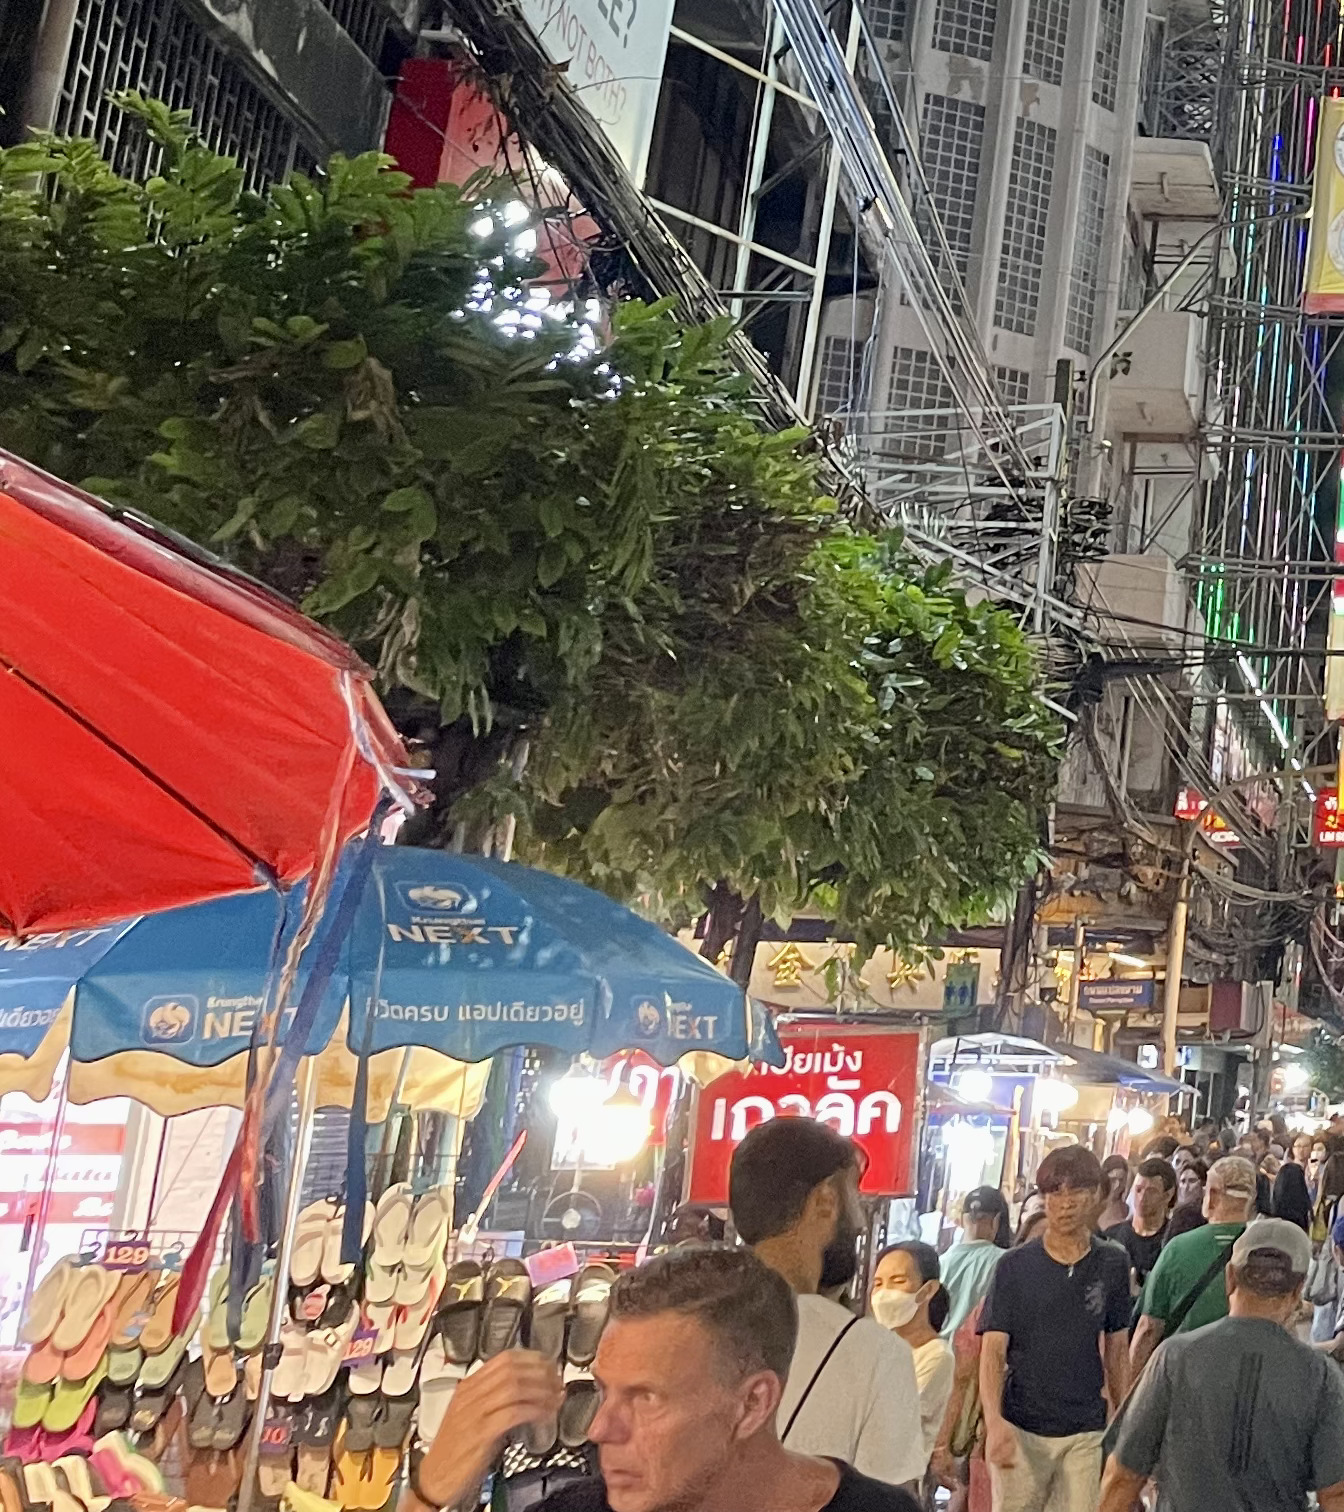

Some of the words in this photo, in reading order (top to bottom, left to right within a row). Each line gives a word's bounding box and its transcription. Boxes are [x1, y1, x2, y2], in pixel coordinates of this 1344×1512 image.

[556, 6, 587, 65] NOT
[584, 41, 628, 122] BOTH?
[386, 923, 519, 945] NEXT
[459, 999, 584, 1027] แอปเดียวอยู่
[106, 1245, 149, 1265] 129
